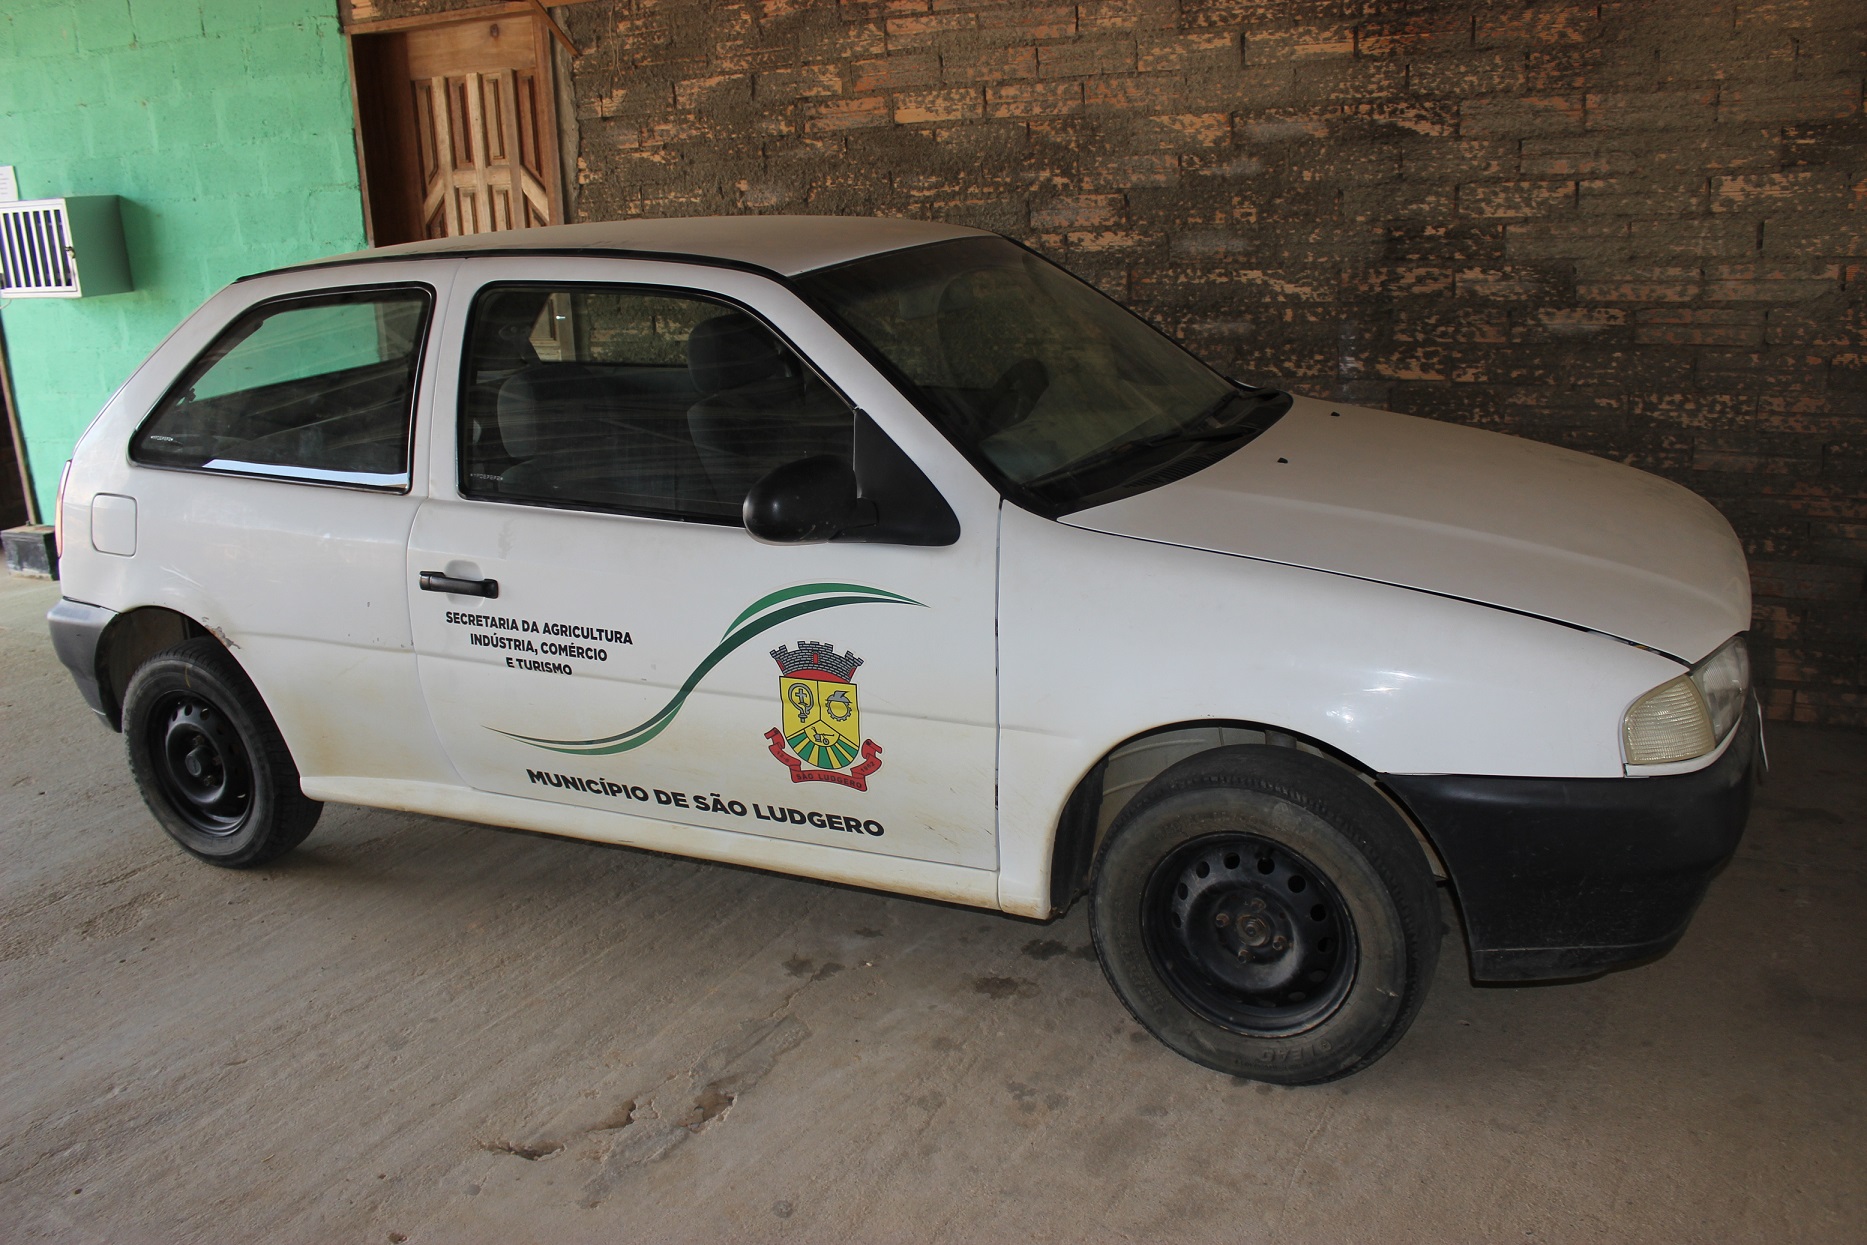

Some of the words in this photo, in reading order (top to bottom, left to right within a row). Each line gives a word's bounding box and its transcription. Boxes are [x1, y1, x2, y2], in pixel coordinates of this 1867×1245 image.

[446, 611, 519, 632] SECRETARIA
[521, 620, 540, 634] DA
[542, 622, 633, 645] AGRICULTURA
[470, 632, 539, 656] INDÚSTRIA,
[540, 642, 608, 662] COMÉRCIO
[505, 657, 515, 668] E
[516, 658, 573, 676] TURISMO
[818, 773, 862, 789] LUDGERO
[526, 768, 650, 803] MUNICÍPIO
[652, 789, 690, 810] DE
[692, 792, 748, 818] SÃO
[752, 803, 885, 838] LUDGERO
